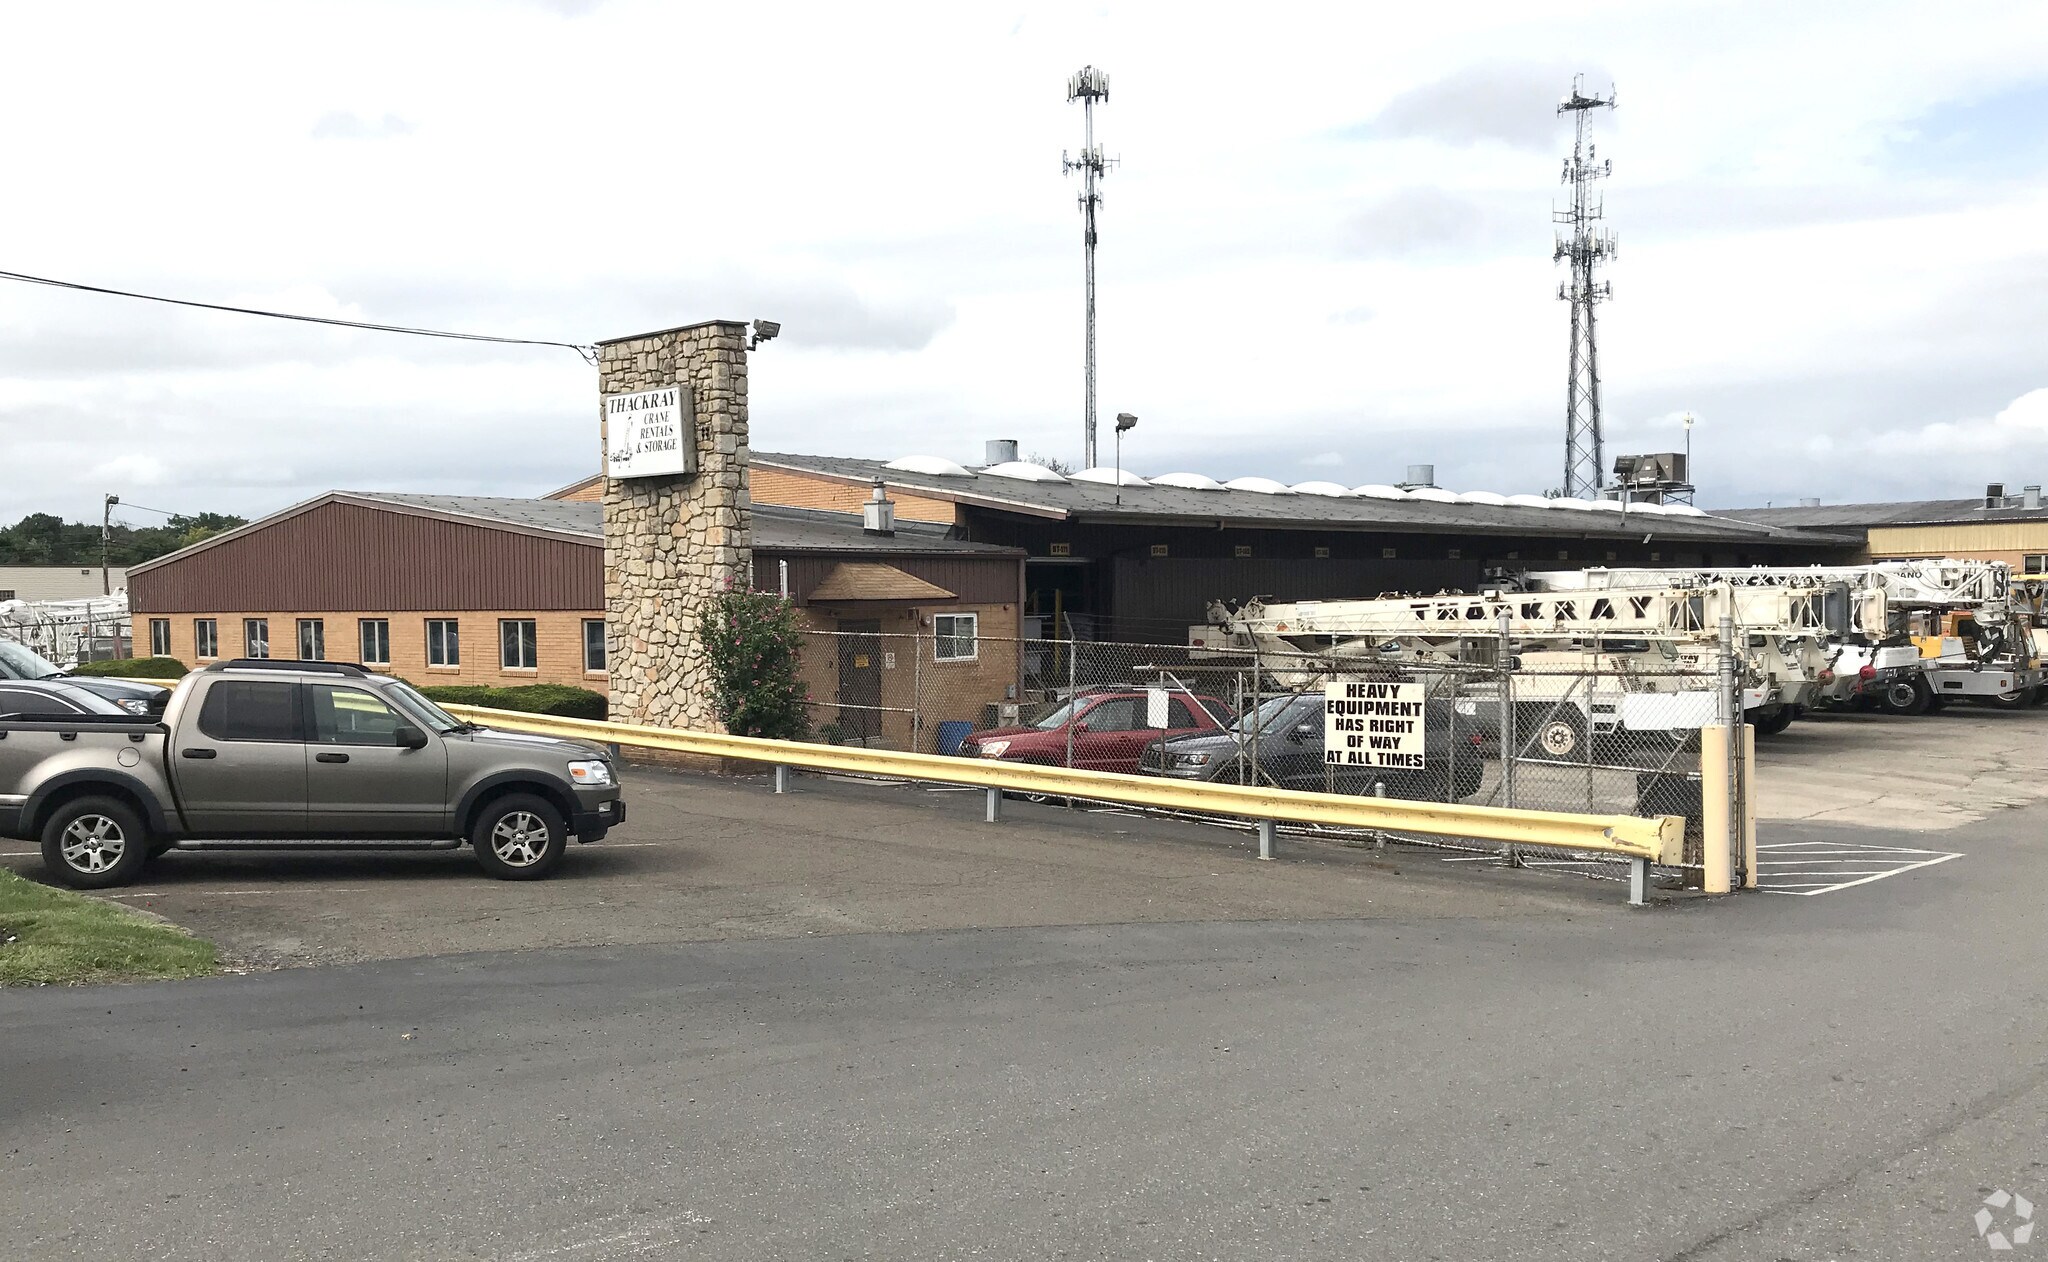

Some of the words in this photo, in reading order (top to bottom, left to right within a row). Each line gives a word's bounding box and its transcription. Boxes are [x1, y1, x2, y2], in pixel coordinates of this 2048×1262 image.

[610, 390, 677, 414] THACKRAY
[644, 411, 670, 425] CRANE
[640, 424, 673, 439] RENTALS
[636, 443, 641, 453] &
[644, 439, 677, 453] STORAGE
[1346, 684, 1401, 699] HEAVY
[1327, 700, 1422, 717] EQUIPMENT
[1335, 718, 1364, 731] HAS
[1370, 719, 1414, 733] RIGHT
[1347, 735, 1364, 748] OF
[1369, 736, 1401, 750] WAY
[1327, 750, 1342, 763] AT
[1347, 751, 1372, 764] ALL
[1377, 752, 1423, 767] TIMES
